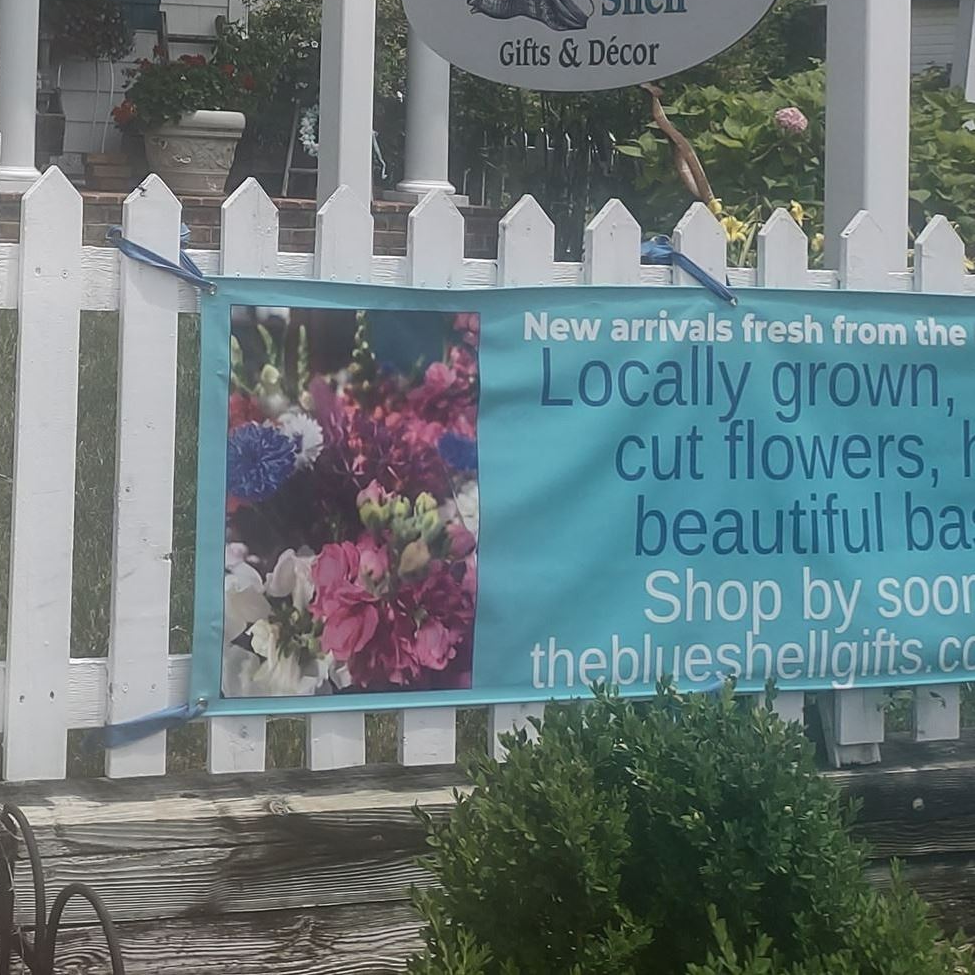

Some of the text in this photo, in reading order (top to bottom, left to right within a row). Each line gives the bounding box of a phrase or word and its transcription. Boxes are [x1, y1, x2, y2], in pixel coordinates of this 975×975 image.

[499, 35, 660, 68] Gifts & Décor
[523, 310, 967, 346] New arrivals fresh from the
[540, 345, 955, 423] Locally grown,
[615, 425, 704, 481] cut
[724, 419, 940, 488] flowers,
[635, 491, 975, 557] beautiful ba
[643, 568, 782, 635] Shop
[802, 567, 862, 633] by
